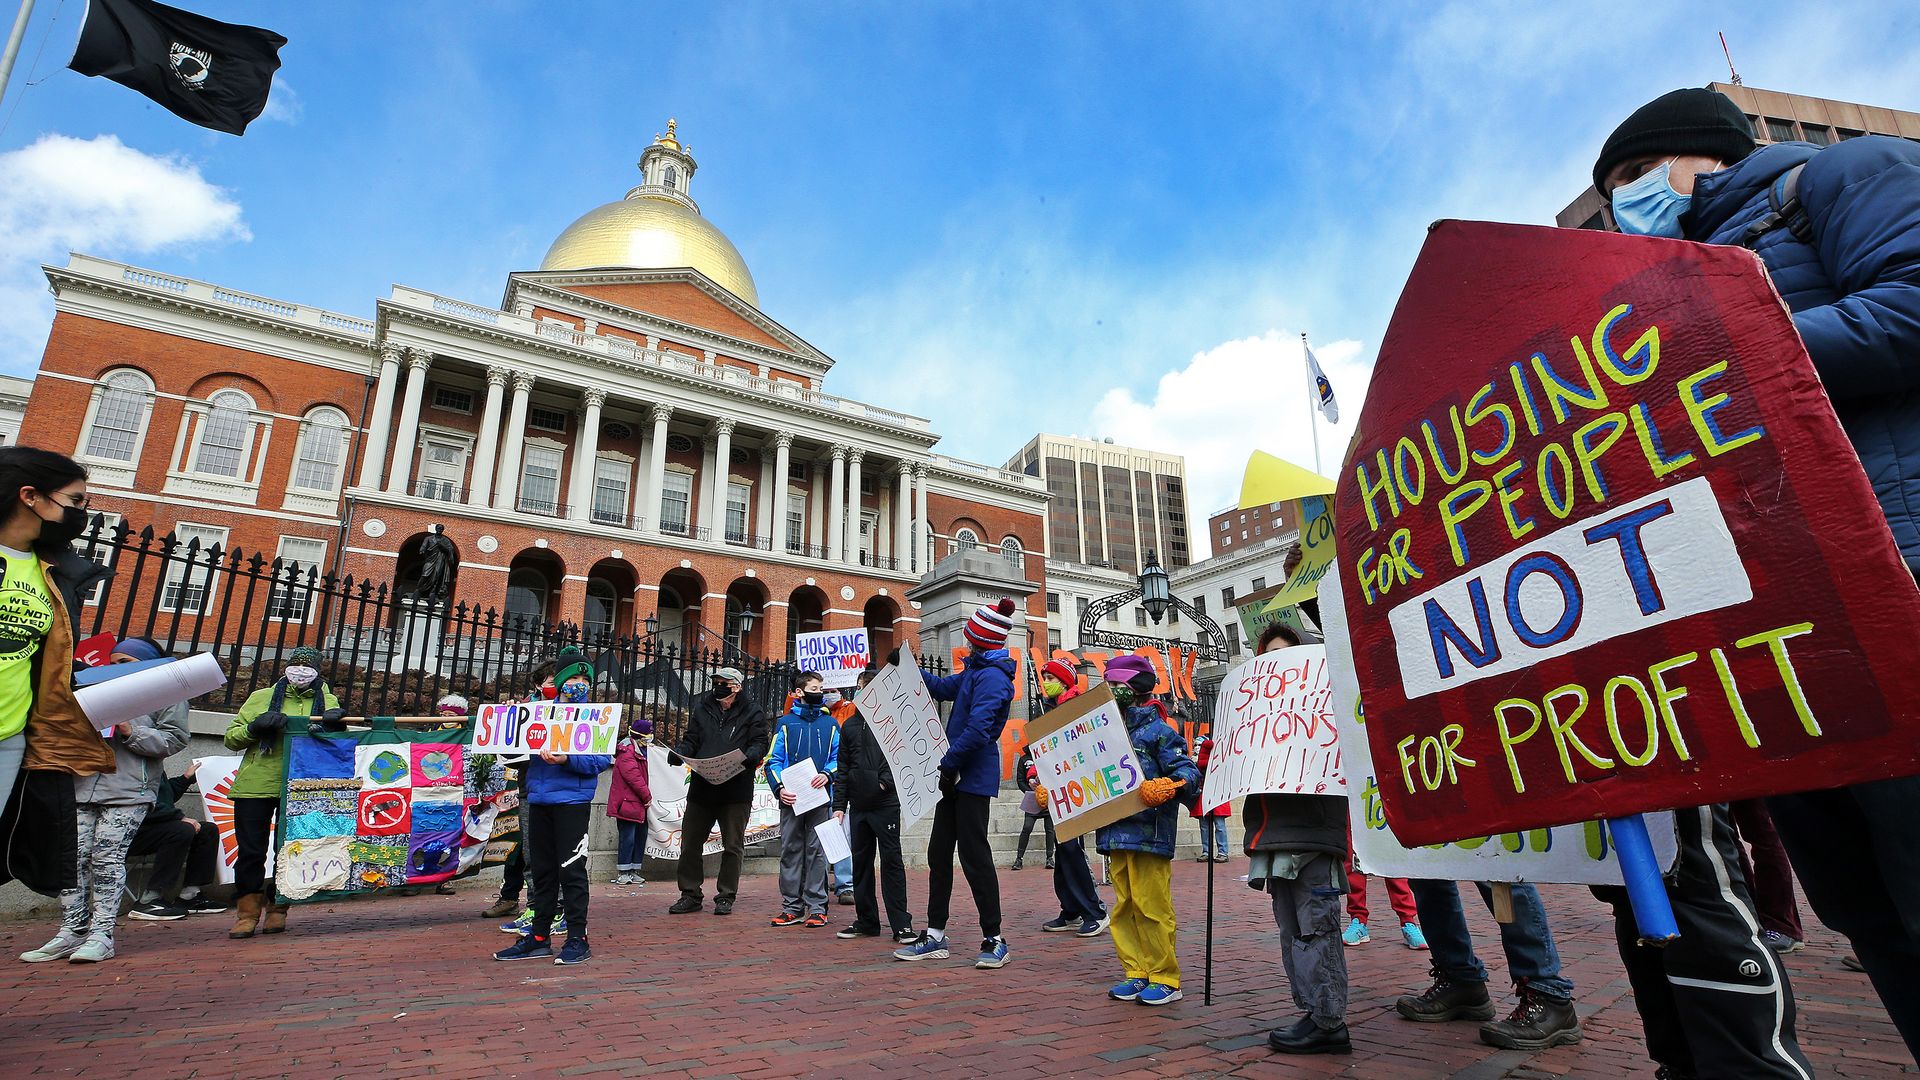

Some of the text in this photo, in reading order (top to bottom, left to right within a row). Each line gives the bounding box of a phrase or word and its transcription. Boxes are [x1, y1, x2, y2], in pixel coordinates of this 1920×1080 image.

[170, 42, 212, 69] POW-MIA
[1357, 303, 1660, 532] HOUSING
[1357, 360, 1766, 605] FOR PEOPLE
[10, 596, 30, 606] WE
[13, 580, 36, 595] VIDA
[1423, 499, 1675, 680] NOT
[24, 608, 50, 620] NOT
[799, 633, 865, 656] HOUSING
[801, 653, 869, 672] EQUITY NOW
[477, 704, 612, 748] STOP EVICTIONS
[1397, 621, 1822, 794] FOR PROFIT
[528, 728, 547, 740] STOP
[551, 723, 616, 754] NOW
[861, 688, 922, 817] DURING COVID
[882, 668, 940, 794] EVICTIONS
[1033, 736, 1059, 760] KEEP
[1064, 713, 1109, 743] FAMILIES
[1210, 712, 1339, 774] EVICTIONS
[1055, 740, 1107, 776] SAFE IN
[1051, 754, 1137, 819] HOMES
